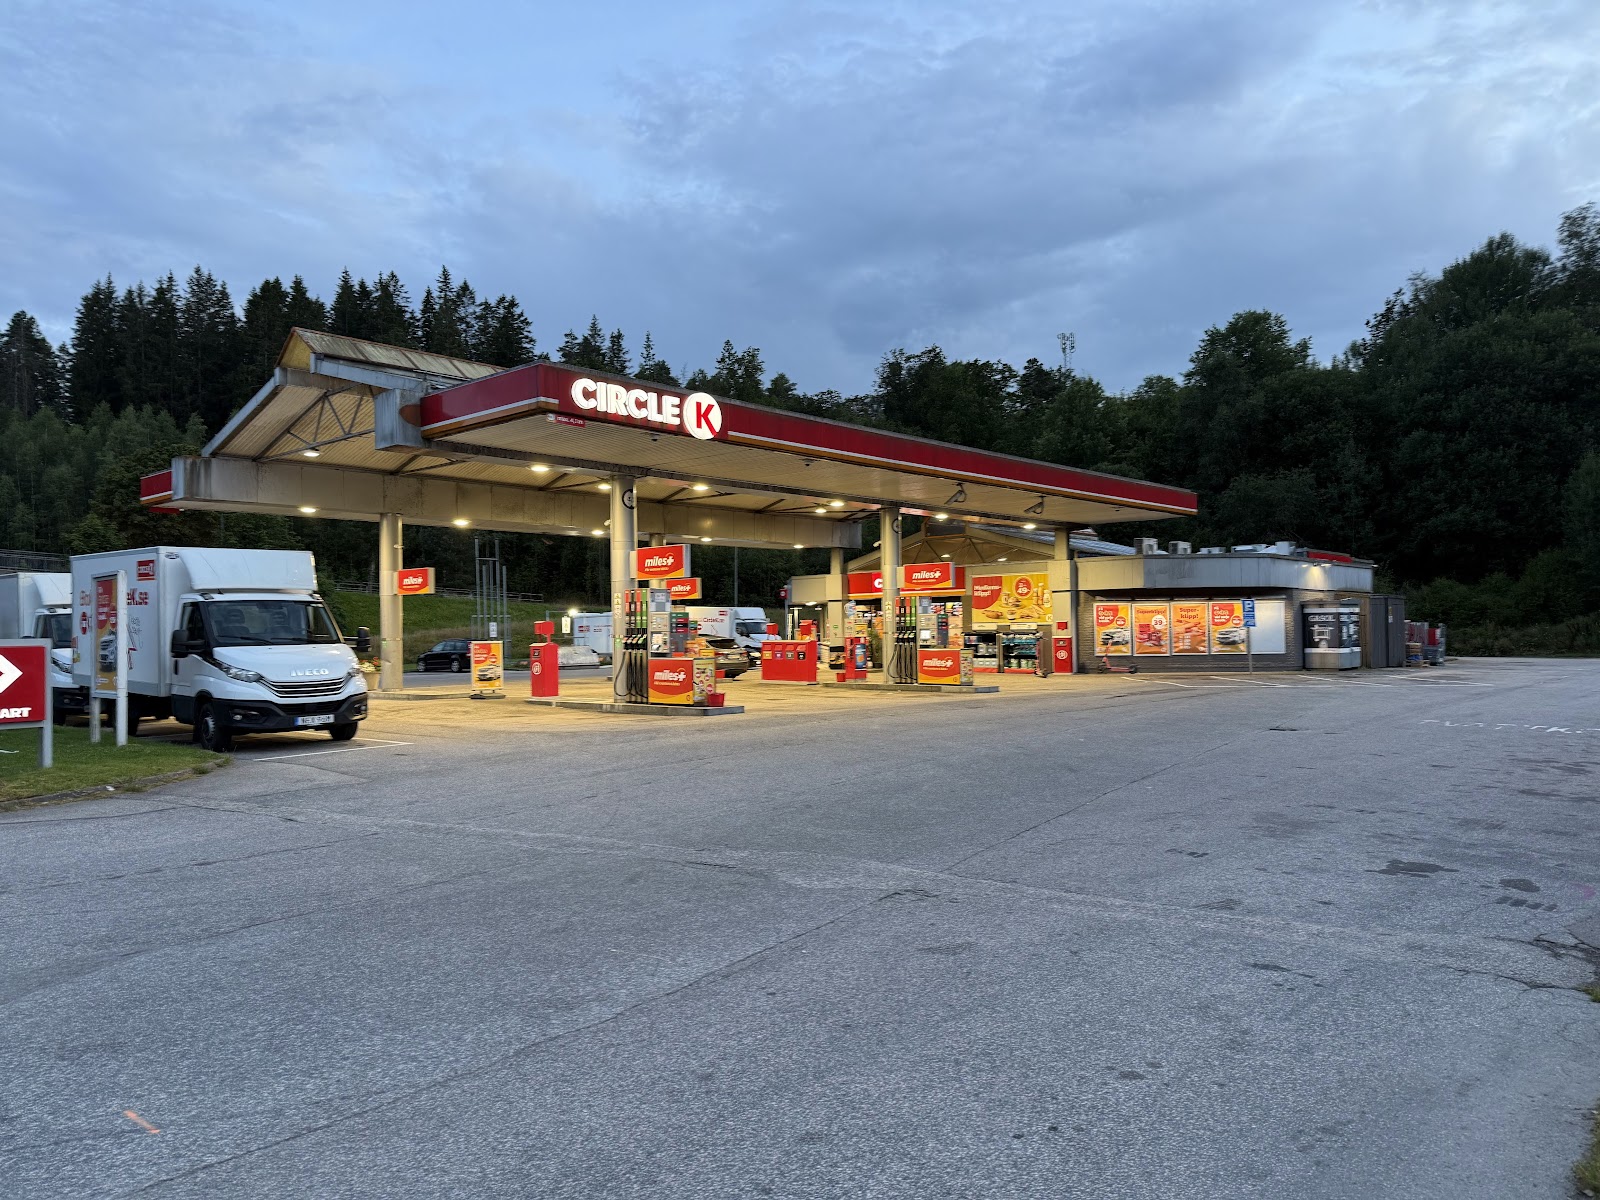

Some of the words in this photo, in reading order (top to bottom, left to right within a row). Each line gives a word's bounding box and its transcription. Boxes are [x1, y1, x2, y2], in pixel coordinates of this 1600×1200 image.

[571, 378, 681, 425] CIRCLE
[695, 401, 718, 437] K
[290, 668, 329, 677] IVECO
